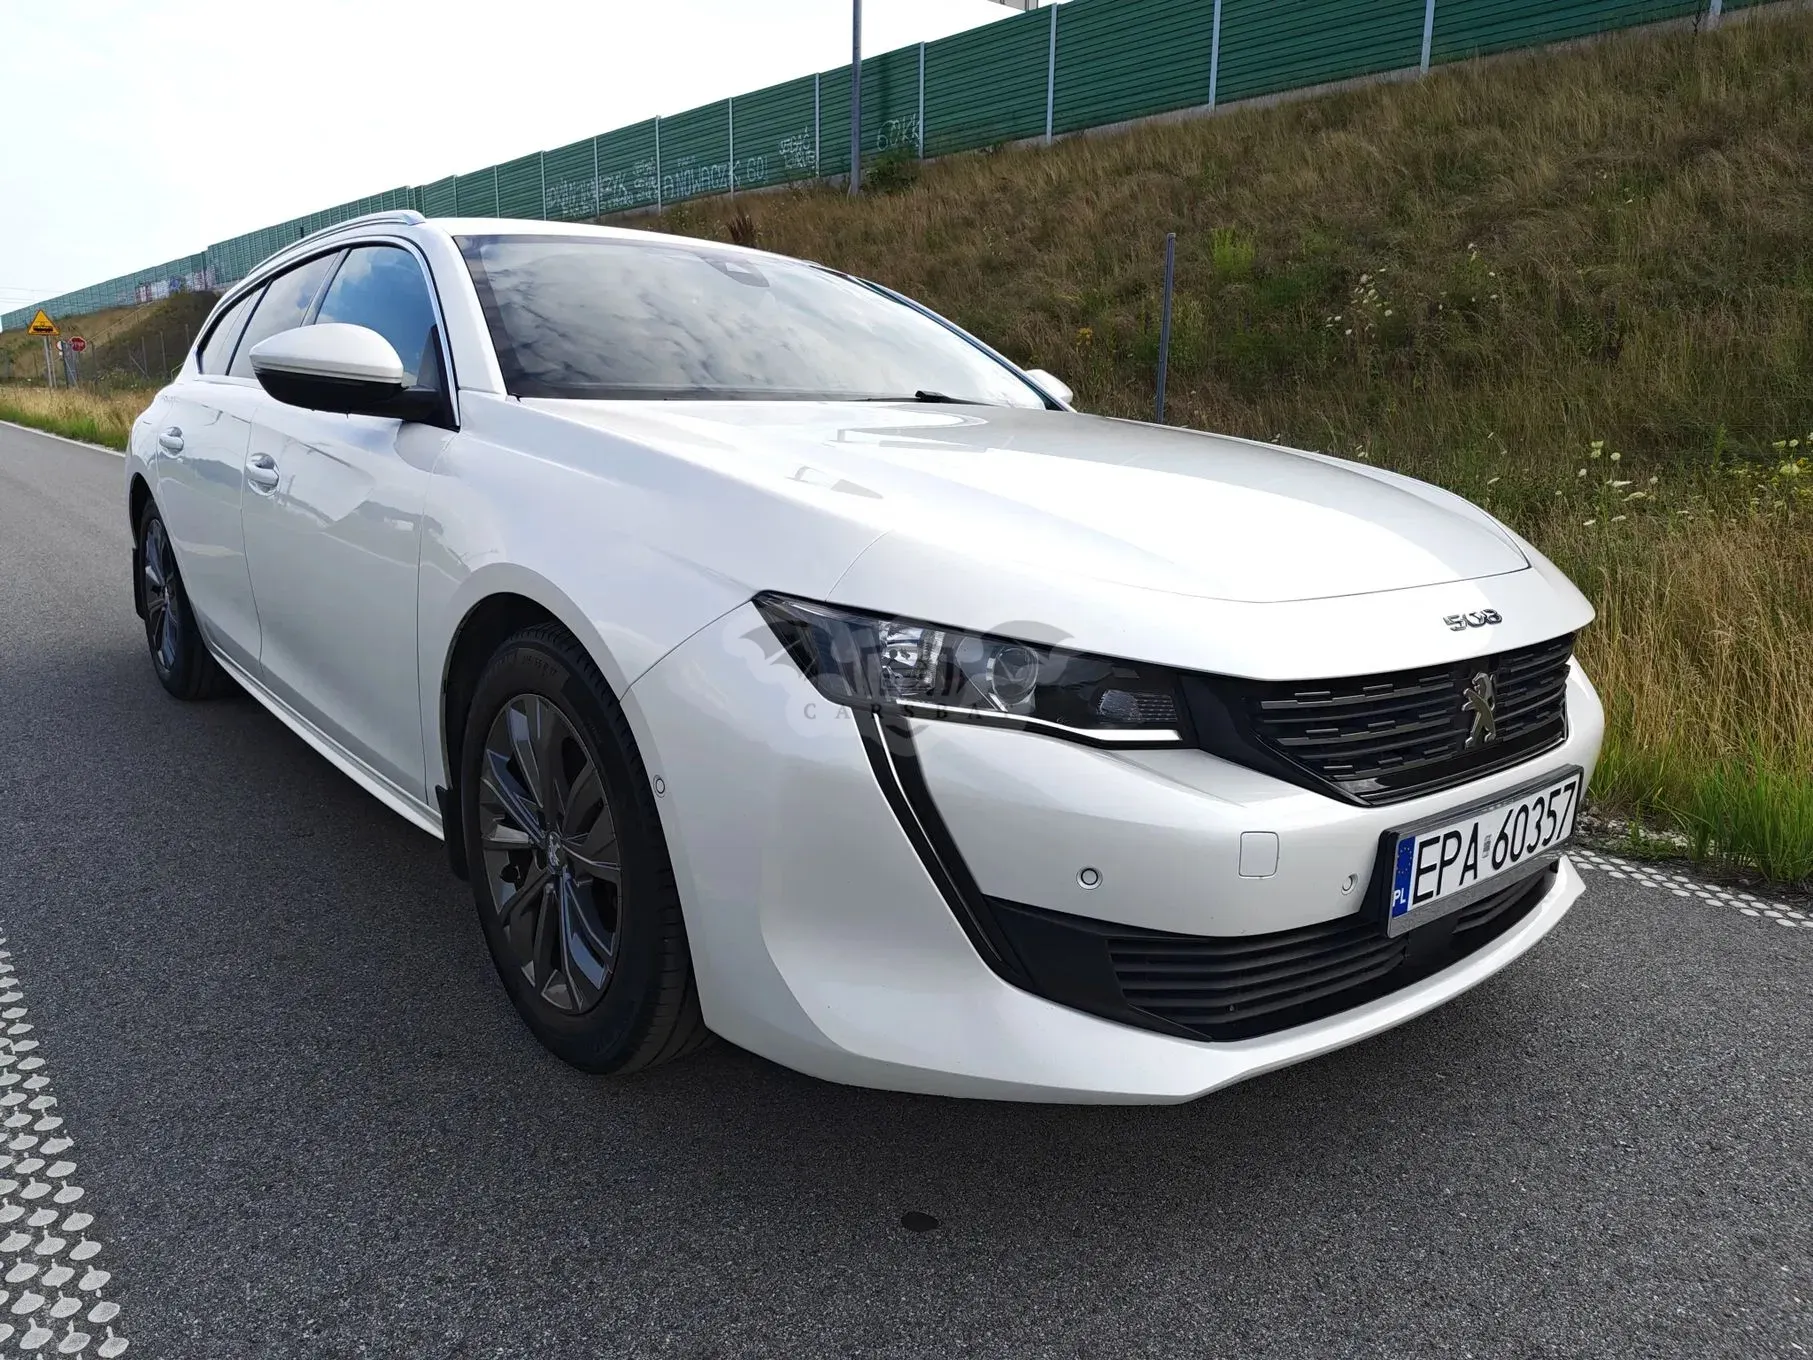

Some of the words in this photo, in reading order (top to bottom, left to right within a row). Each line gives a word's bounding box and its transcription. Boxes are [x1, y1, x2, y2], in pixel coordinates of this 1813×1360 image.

[1444, 608, 1503, 631] 508
[1412, 822, 1479, 905] EPA
[1491, 781, 1577, 870] 60357
[1392, 888, 1406, 907] PL
